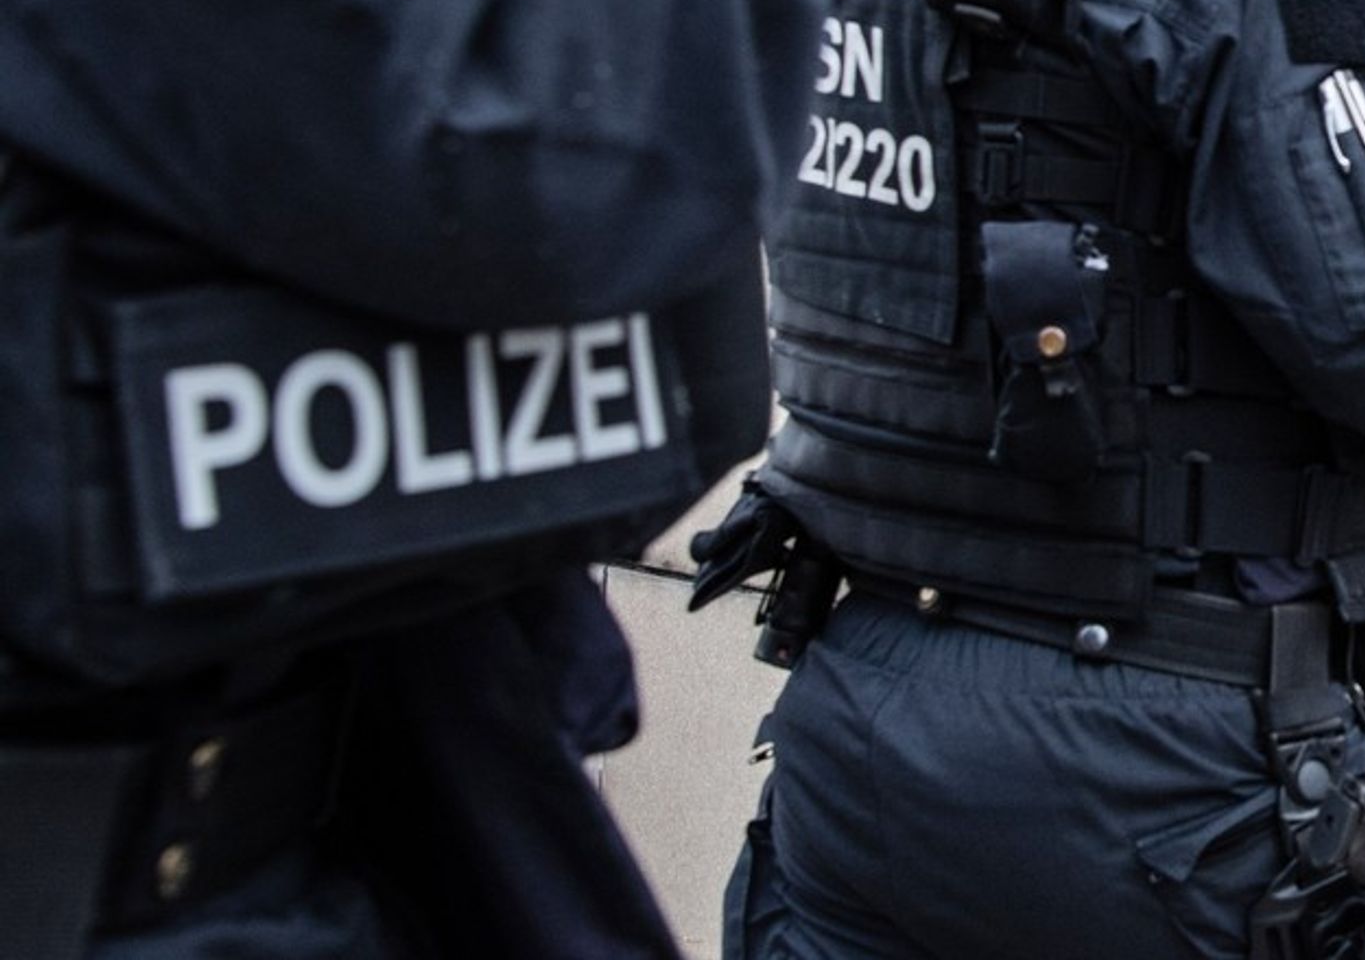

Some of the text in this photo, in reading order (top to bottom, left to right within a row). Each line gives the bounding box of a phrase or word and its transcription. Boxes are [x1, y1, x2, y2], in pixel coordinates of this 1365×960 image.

[814, 17, 883, 102] SN
[797, 115, 936, 213] 2/220
[164, 311, 667, 530] POLIZEI
